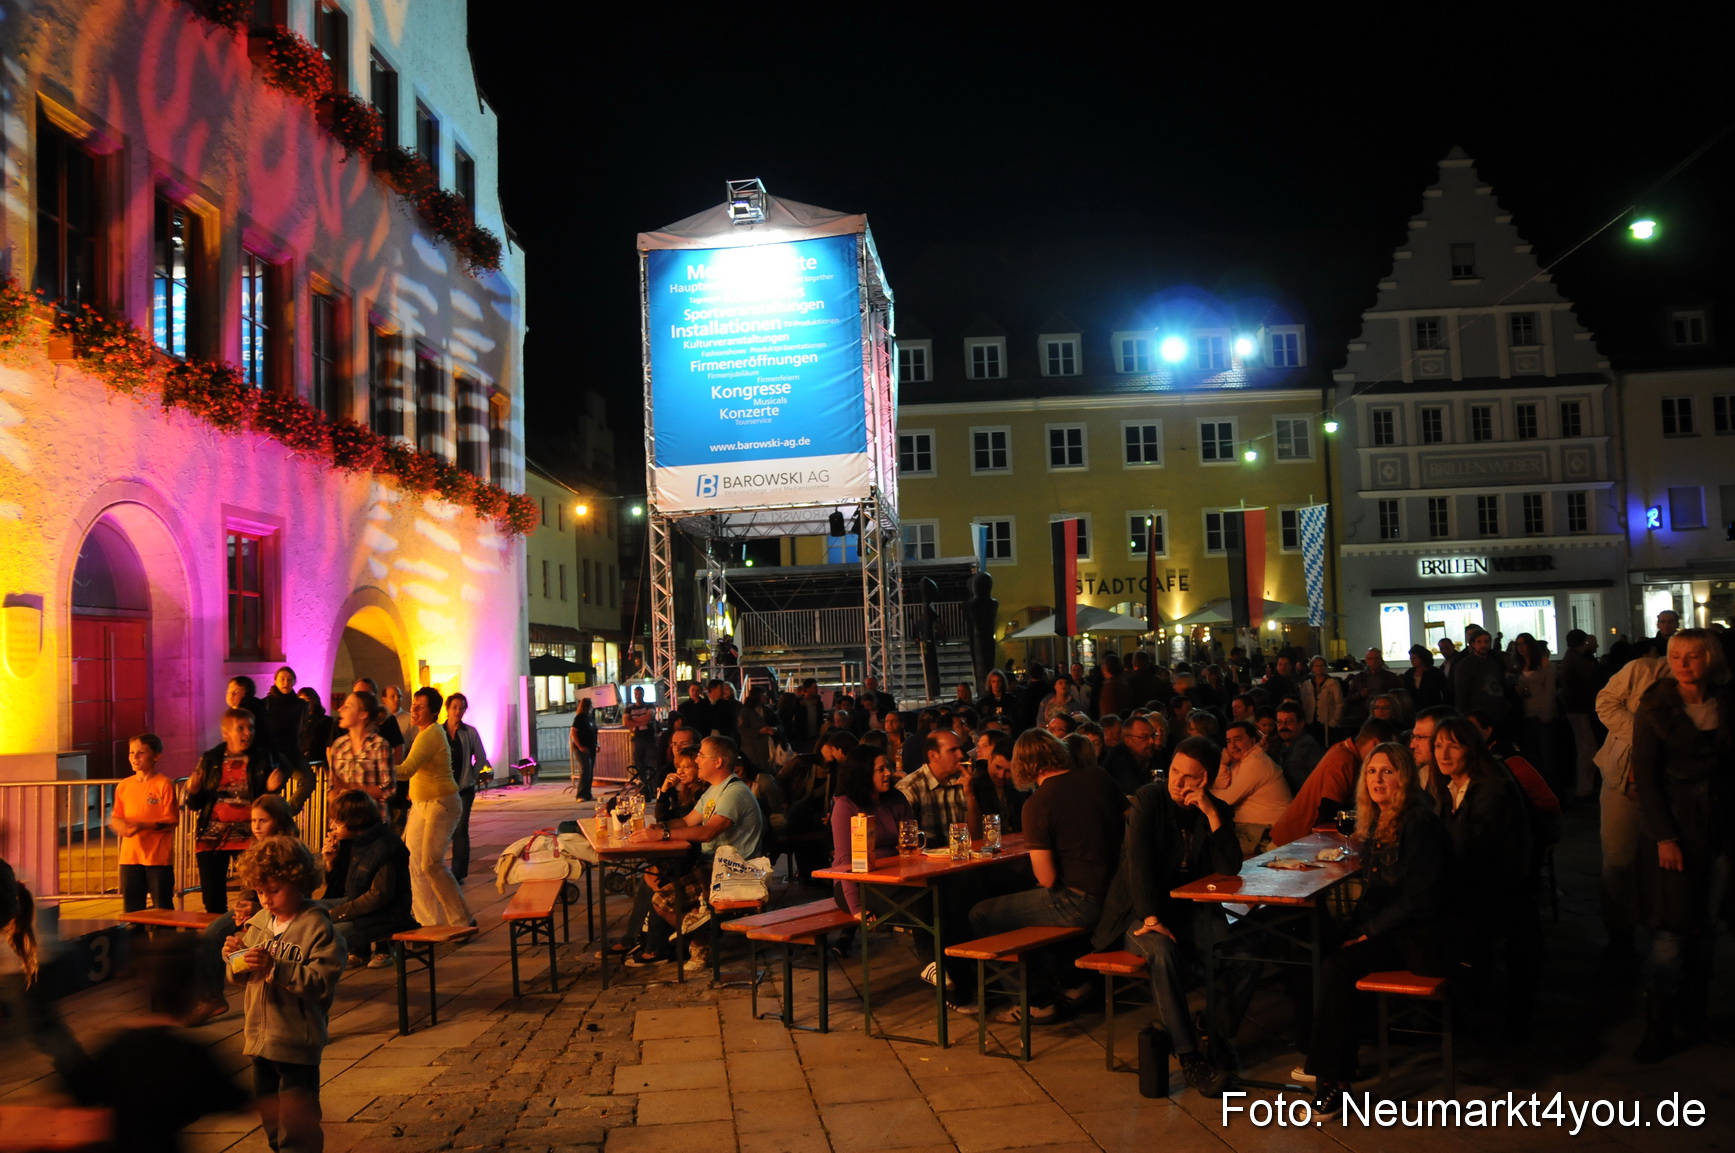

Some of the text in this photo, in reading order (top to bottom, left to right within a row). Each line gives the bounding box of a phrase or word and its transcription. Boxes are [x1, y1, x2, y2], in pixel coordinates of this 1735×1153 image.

[683, 300, 824, 321] Sportveranstaltungen
[671, 317, 781, 339] Installationen
[683, 333, 790, 350] Kulturveranstaltungen
[701, 341, 827, 357] Fashionshows Produktpräsentationen
[690, 352, 818, 373] Firmeneröffnungen
[707, 369, 760, 380] Firmenjubiläum
[756, 374, 800, 383] Firmenfeiern
[711, 381, 792, 400] Kongresse
[753, 396, 787, 406] Musicals
[719, 406, 780, 420] Konzerte
[735, 417, 773, 426] Tourservice
[709, 437, 811, 452] www.barowski-ag.de
[723, 471, 803, 489] BAROWSKI
[807, 470, 830, 483] AG
[1421, 555, 1556, 575] BRILLEN WEBER
[88, 936, 111, 982] 3
